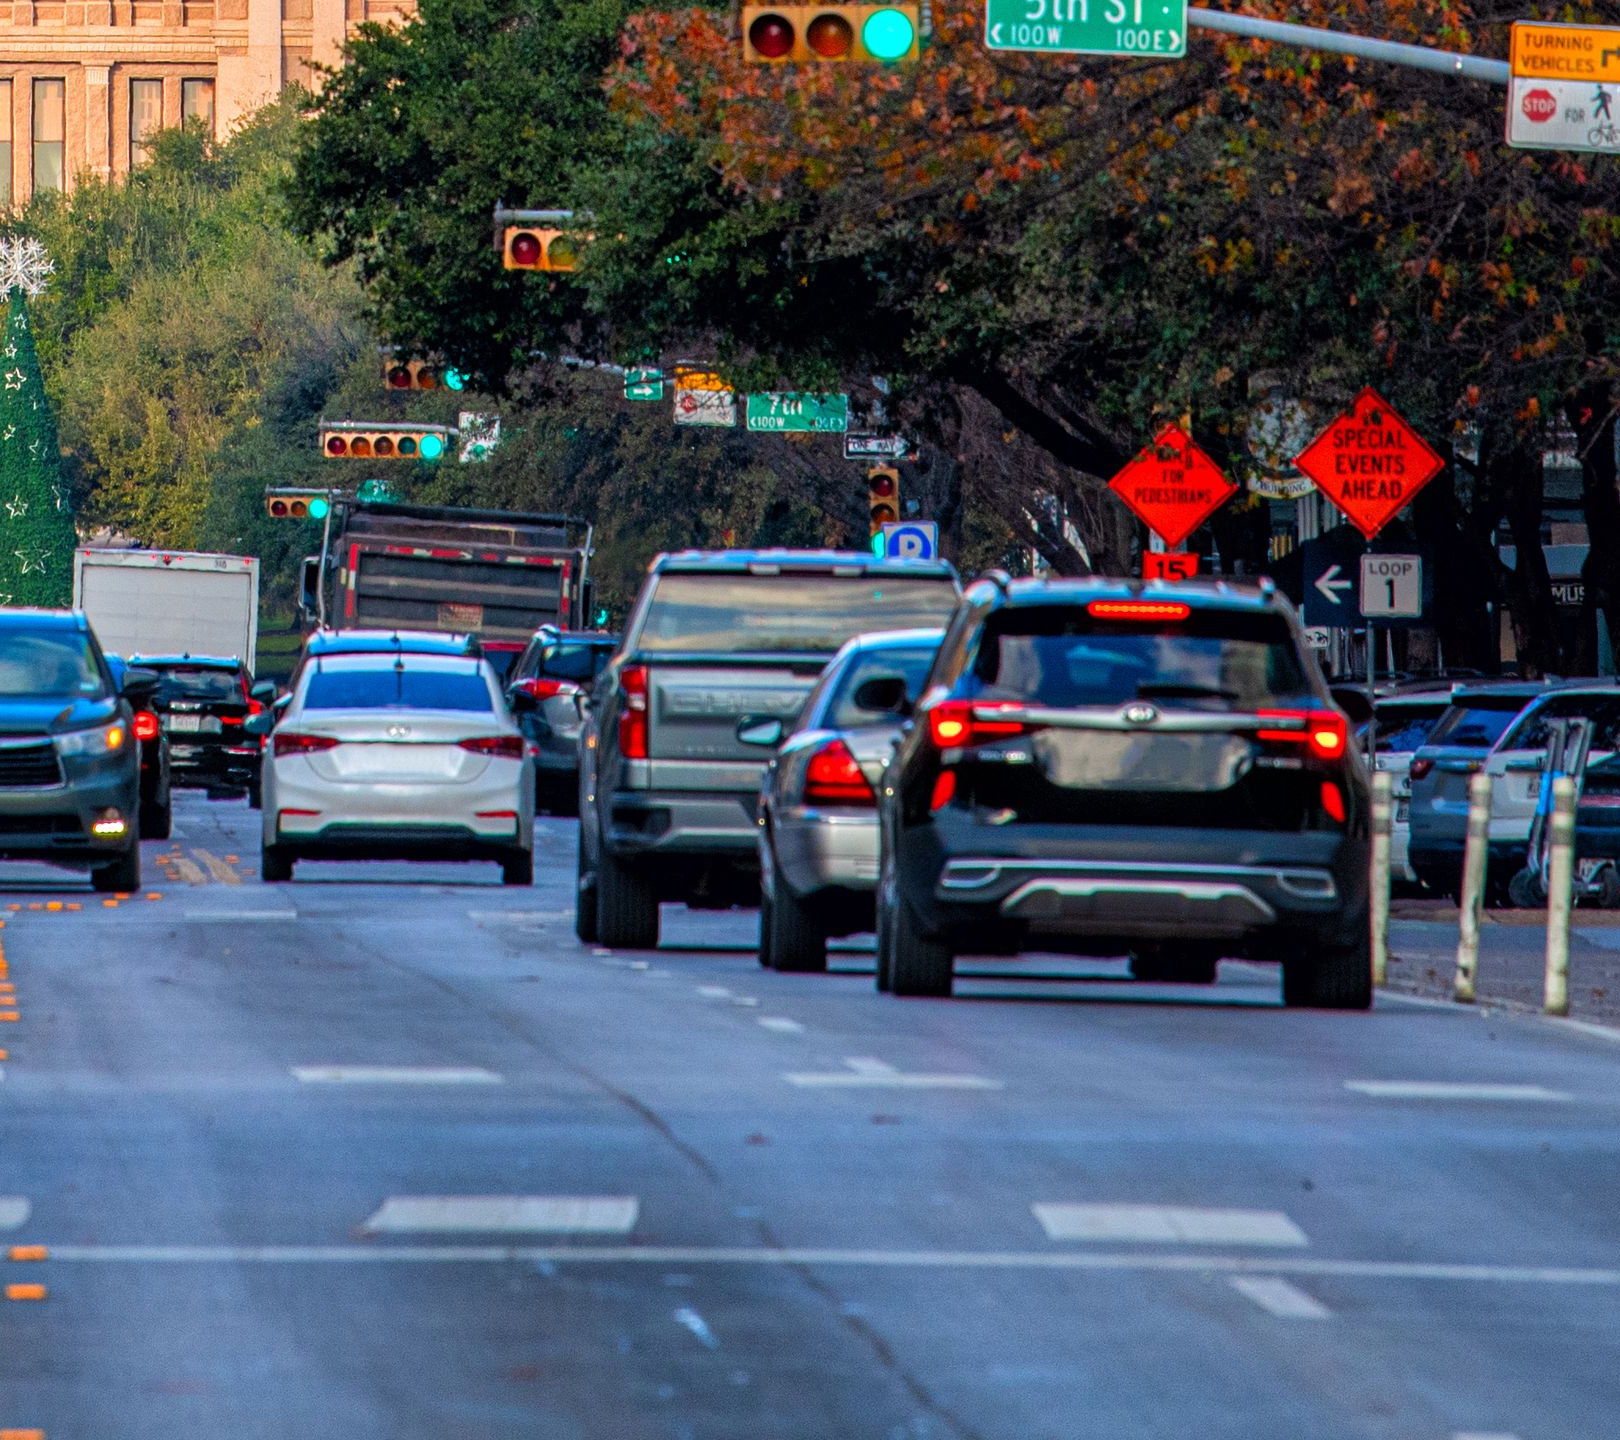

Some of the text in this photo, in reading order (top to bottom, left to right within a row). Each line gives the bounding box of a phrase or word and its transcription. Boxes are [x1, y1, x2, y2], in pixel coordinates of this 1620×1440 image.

[1010, 24, 1165, 51] 100W 100E
[1522, 33, 1594, 51] TURNING
[1521, 52, 1595, 74] VEHICLES
[1522, 96, 1556, 114] STOP
[1565, 107, 1586, 122] FOR
[1332, 428, 1408, 450] SPECIAL
[1336, 453, 1405, 475] EVENTS
[1134, 488, 1213, 505] PEDESTRIANS
[1340, 479, 1403, 500] AHEAD
[1156, 560, 1188, 580] 15
[1369, 560, 1413, 577] LOOP
[1384, 578, 1396, 608] 1
